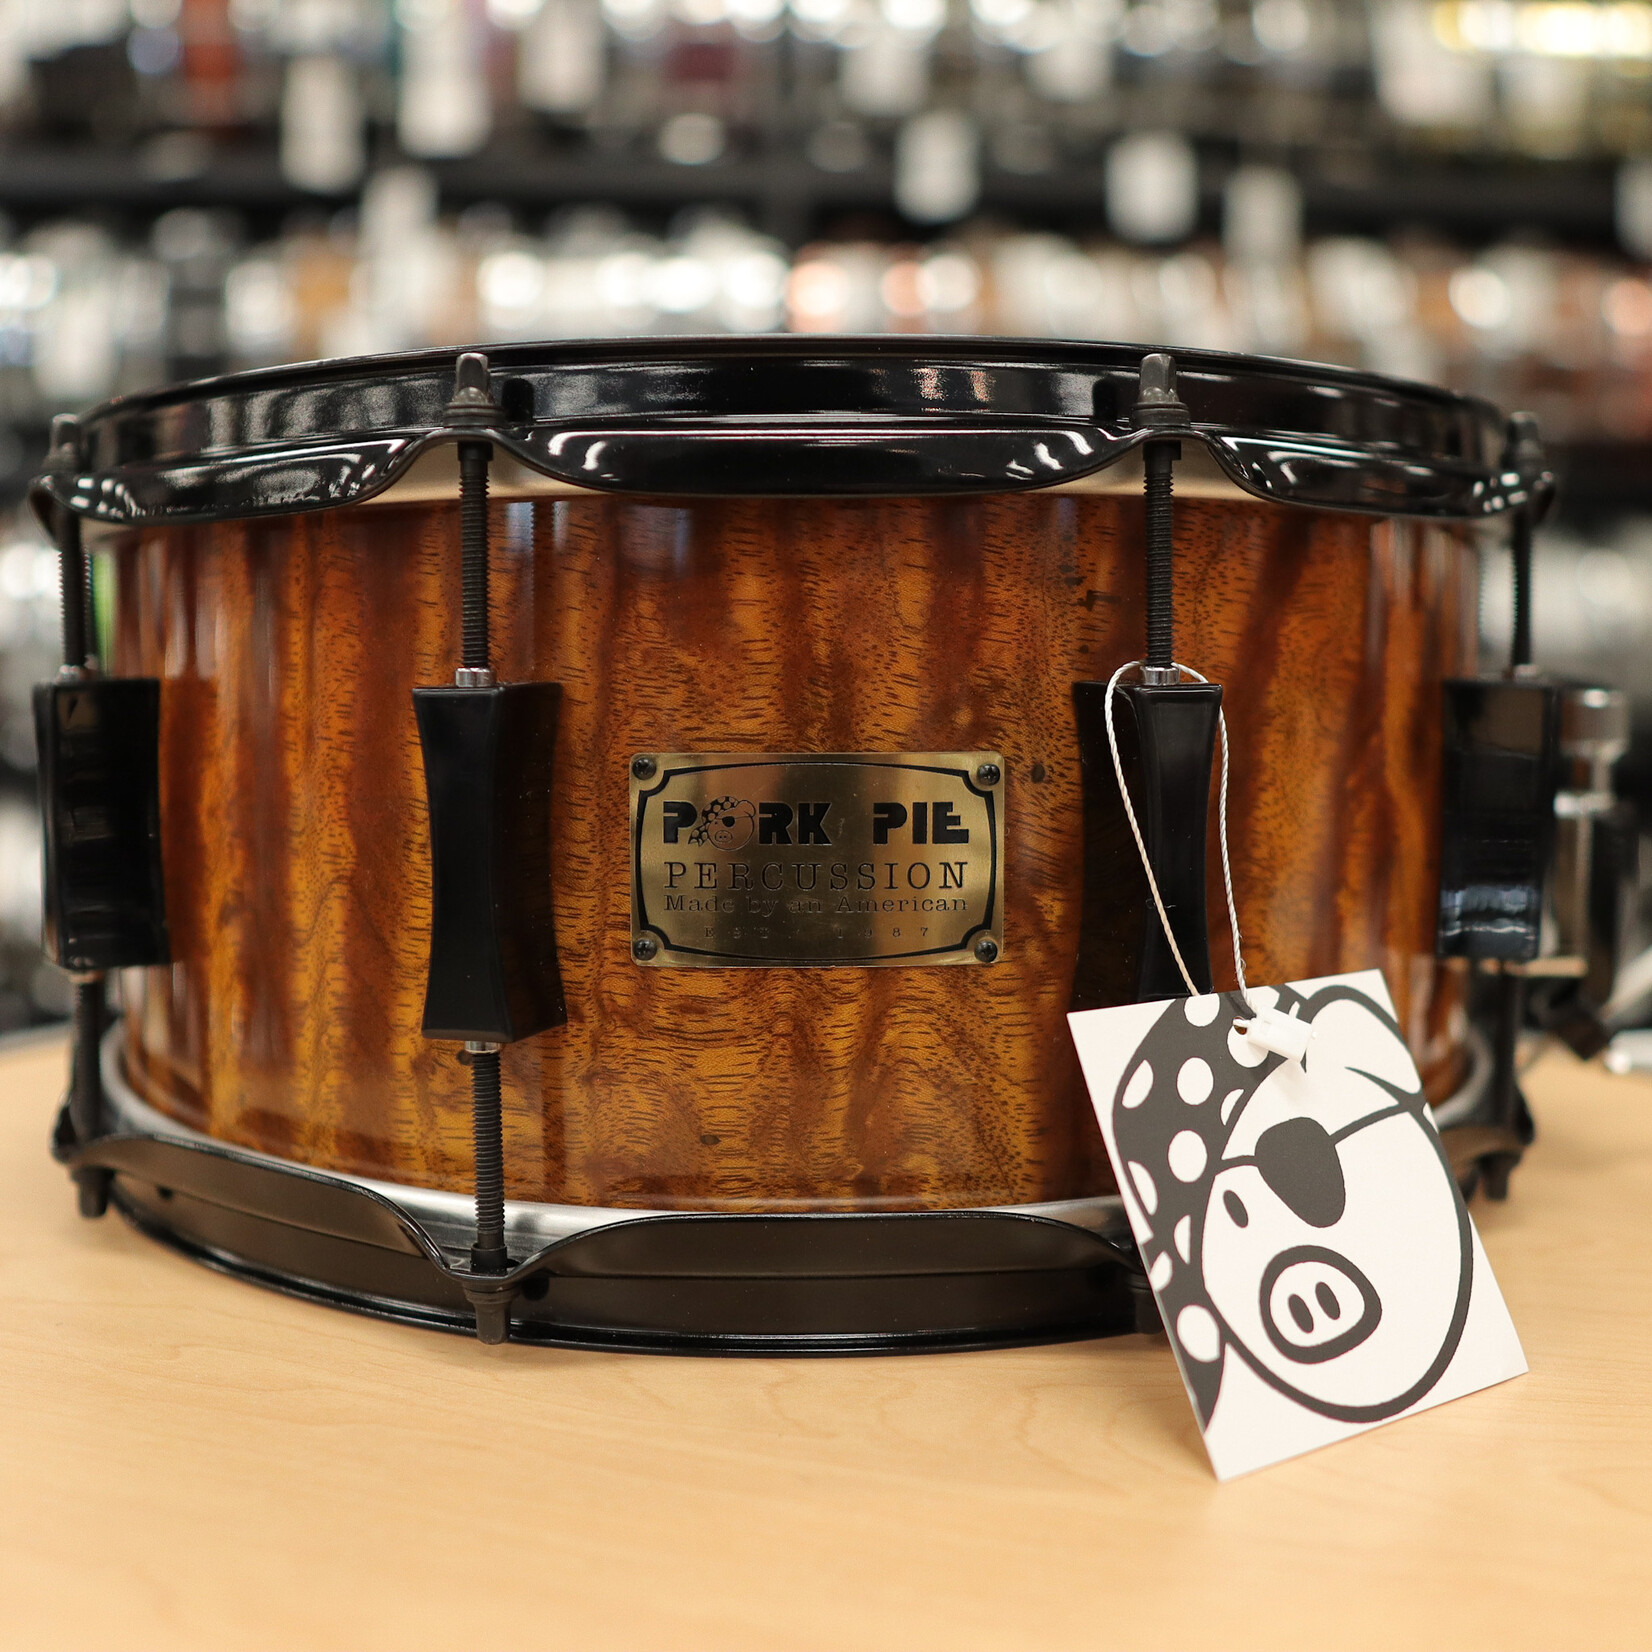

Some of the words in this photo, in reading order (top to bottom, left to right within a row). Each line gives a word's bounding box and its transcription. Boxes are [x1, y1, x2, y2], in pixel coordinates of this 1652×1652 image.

[873, 801, 970, 845] PIE
[664, 861, 969, 891] PERCUSSION
[664, 894, 735, 913] Made
[748, 893, 779, 917] by
[788, 898, 822, 913] an
[836, 893, 969, 913] American
